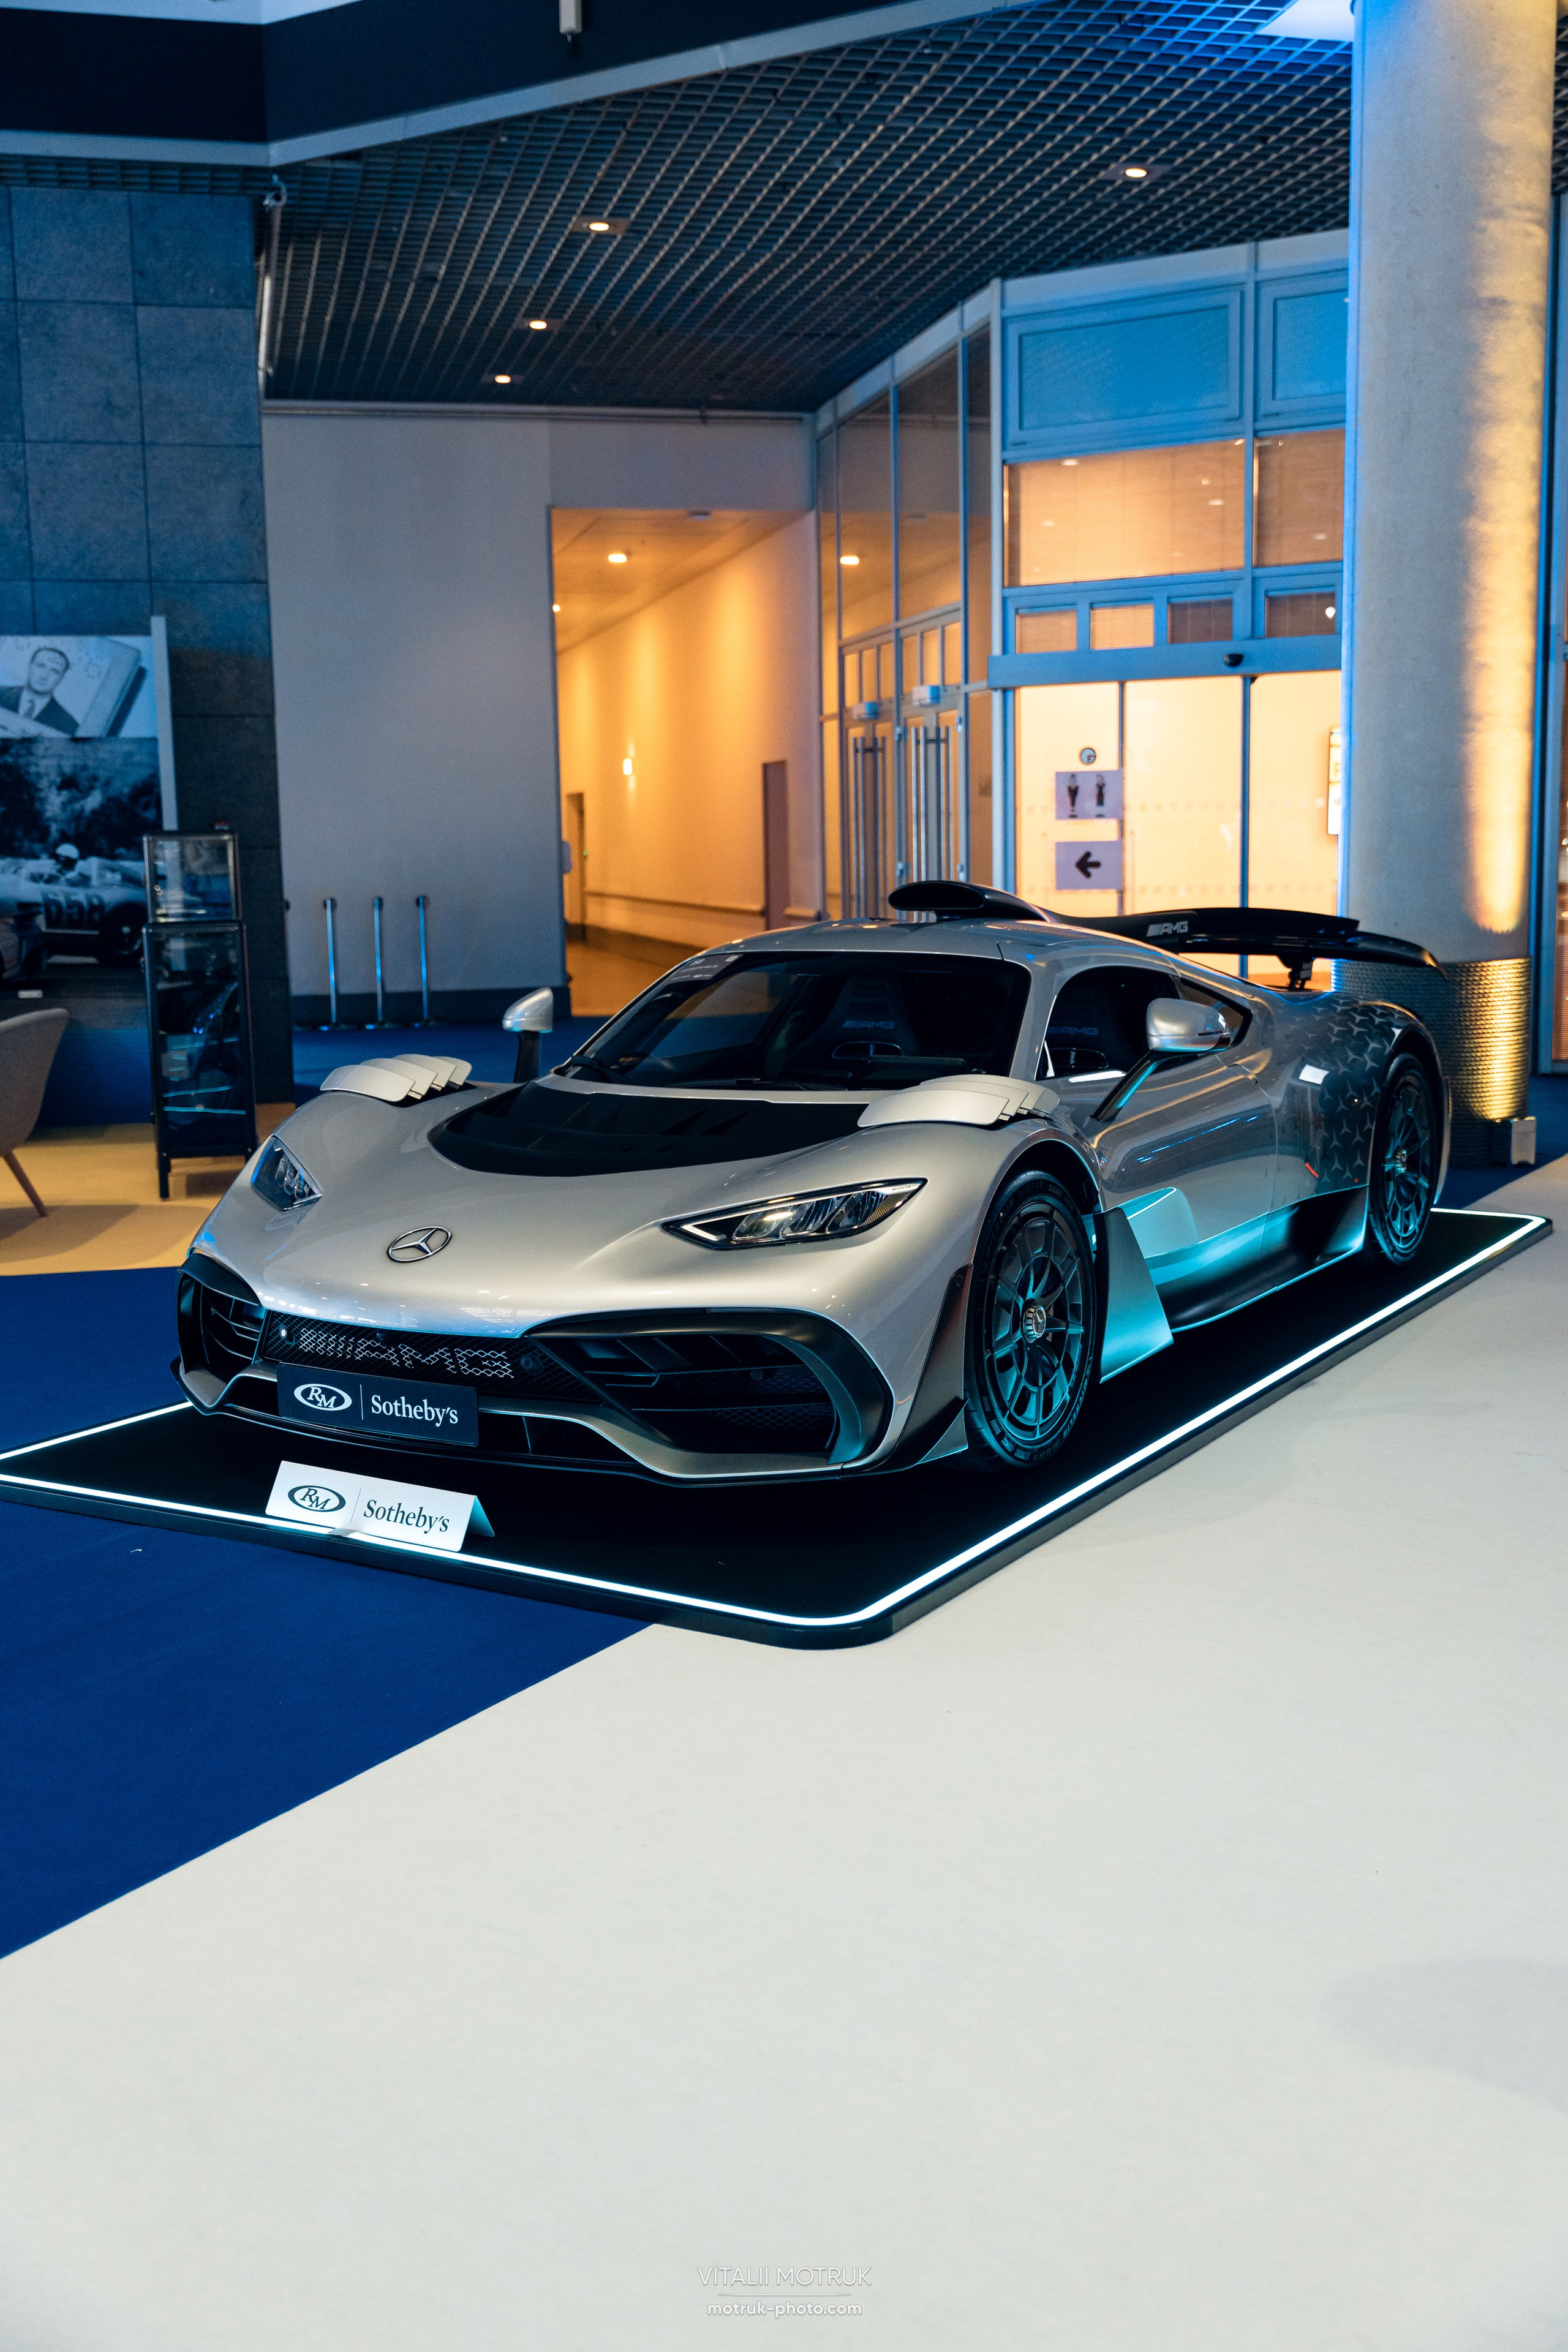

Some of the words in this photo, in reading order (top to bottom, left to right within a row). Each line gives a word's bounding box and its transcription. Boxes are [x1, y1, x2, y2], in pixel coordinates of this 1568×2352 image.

[1159, 921, 1189, 935] AMG
[1060, 1027, 1099, 1035] AMG
[355, 1338, 514, 1378] AMG
[371, 1395, 458, 1427] Sotheby's
[1062, 1376, 1088, 1441] MICHELIN
[363, 1499, 450, 1534] Sotheby's
